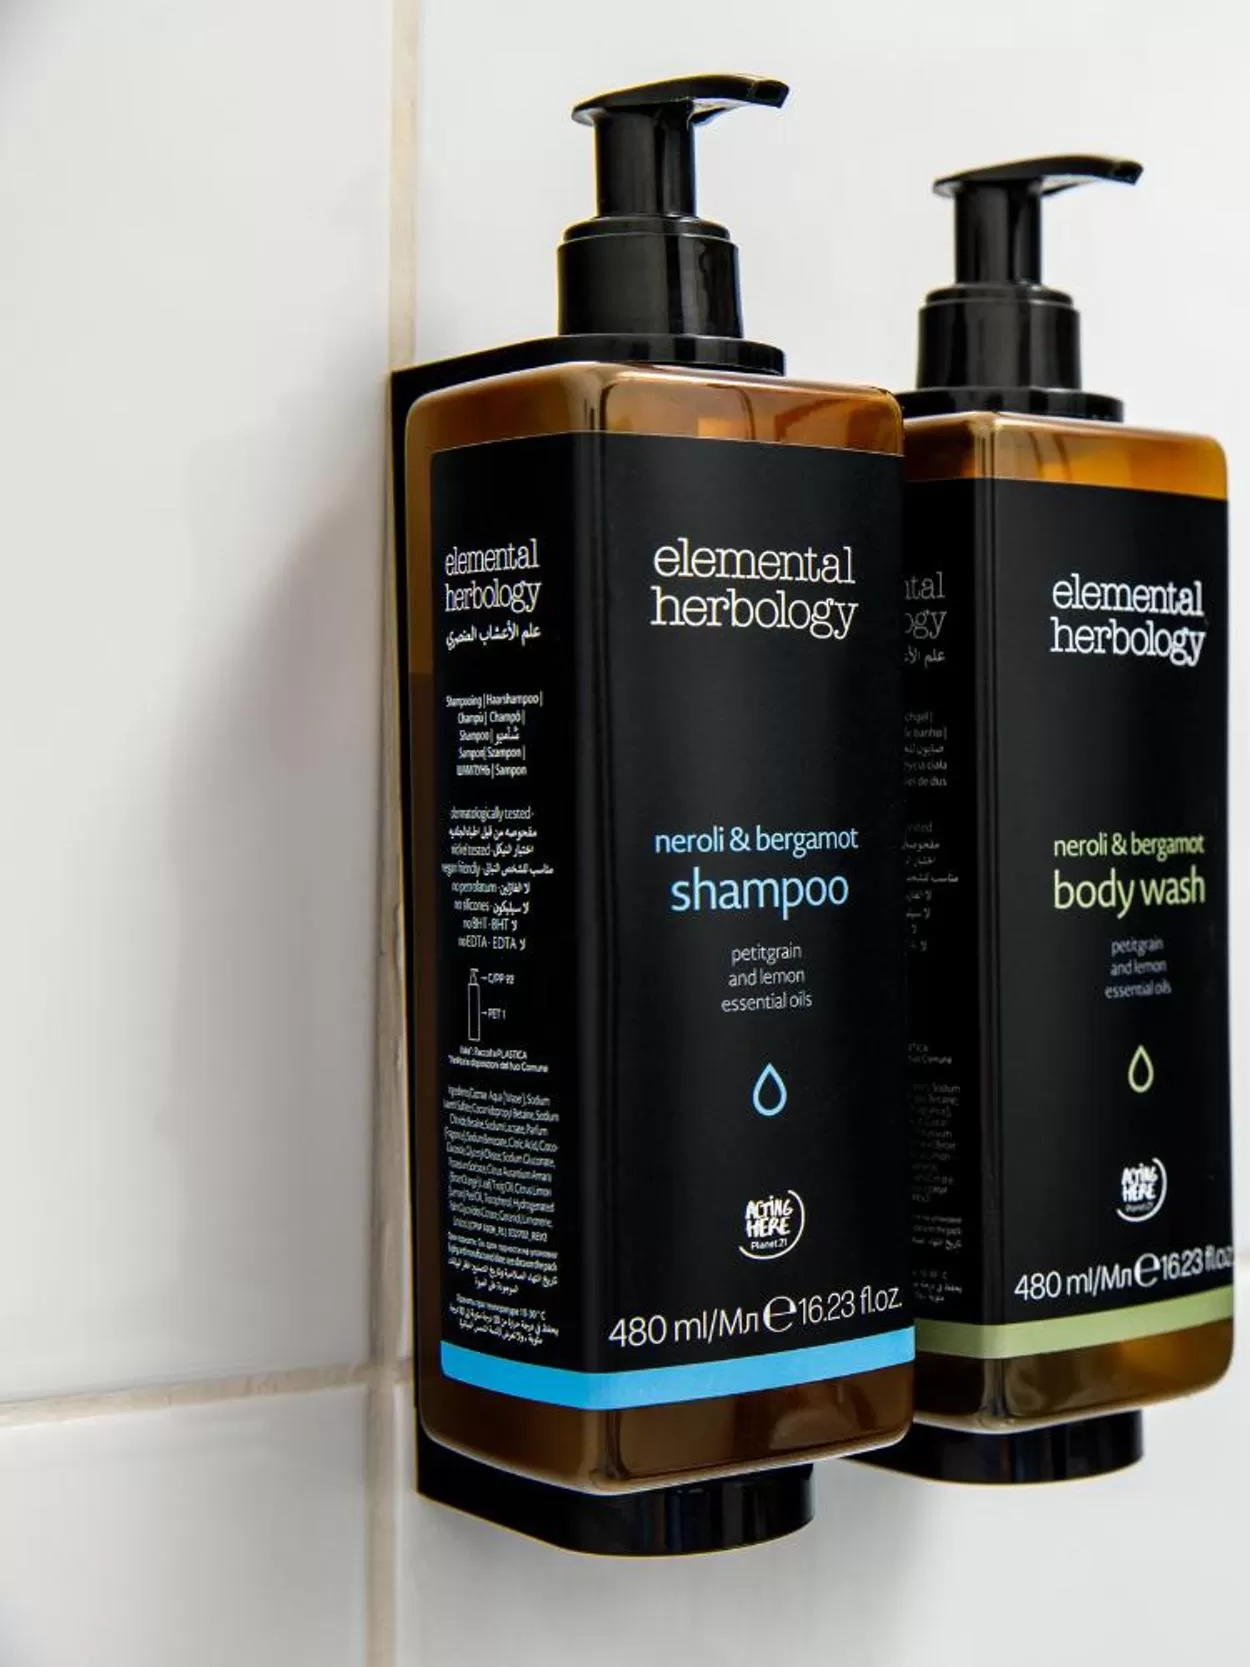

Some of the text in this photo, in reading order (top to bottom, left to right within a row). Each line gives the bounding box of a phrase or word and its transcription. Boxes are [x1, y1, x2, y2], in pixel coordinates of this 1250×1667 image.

[445, 538, 540, 576] elemental
[653, 537, 856, 584] elemental
[445, 578, 542, 614] herbology
[1052, 573, 1204, 617] elemental
[650, 585, 859, 640] herbology
[1050, 616, 1207, 667] herbology
[655, 824, 859, 859] neroli & bergamot
[1053, 830, 1205, 863] neroli & bergamot
[670, 866, 849, 921] shampoo
[1053, 864, 1206, 920] body wash
[493, 936, 517, 950] EDTA
[731, 942, 802, 966] petitgrain
[1111, 936, 1165, 957] petitgrain
[728, 968, 805, 987] and lemon
[1110, 960, 1167, 976] and lemon
[721, 991, 813, 1013] essential oils
[521, 1061, 549, 1073] Comune
[746, 1216, 791, 1238] HERE
[1014, 1271, 1061, 1301] 480
[608, 1314, 668, 1347] 480
[799, 1290, 855, 1325] 16.23
